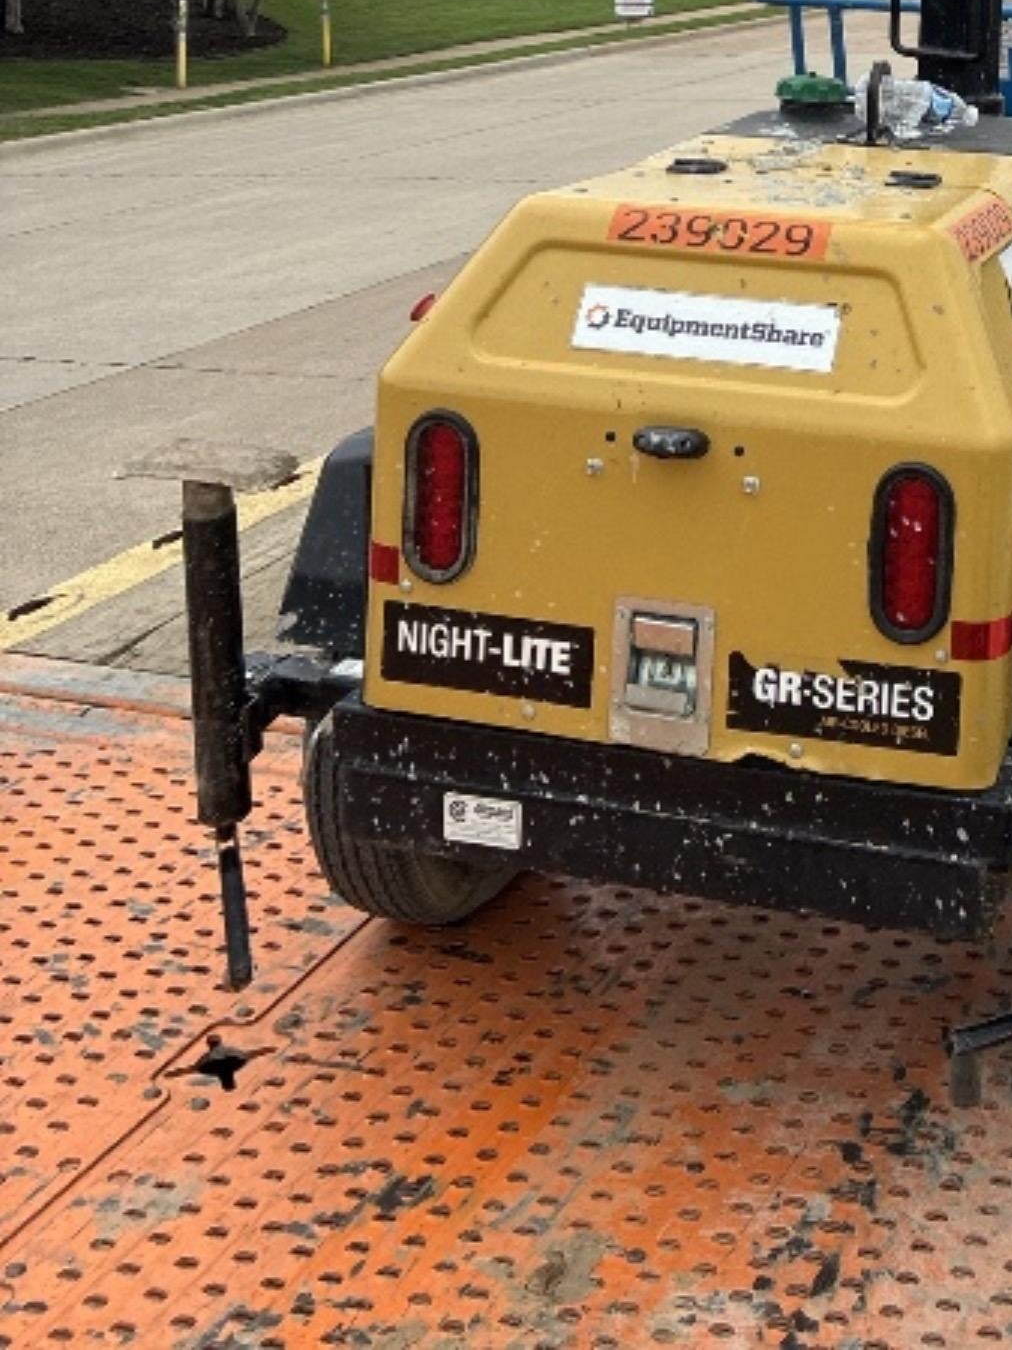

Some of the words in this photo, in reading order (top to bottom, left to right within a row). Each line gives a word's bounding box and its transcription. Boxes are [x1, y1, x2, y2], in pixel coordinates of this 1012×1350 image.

[617, 209, 814, 256] 239029
[614, 308, 825, 347] EquipmentShare
[397, 619, 571, 675] NIGHT-LITE
